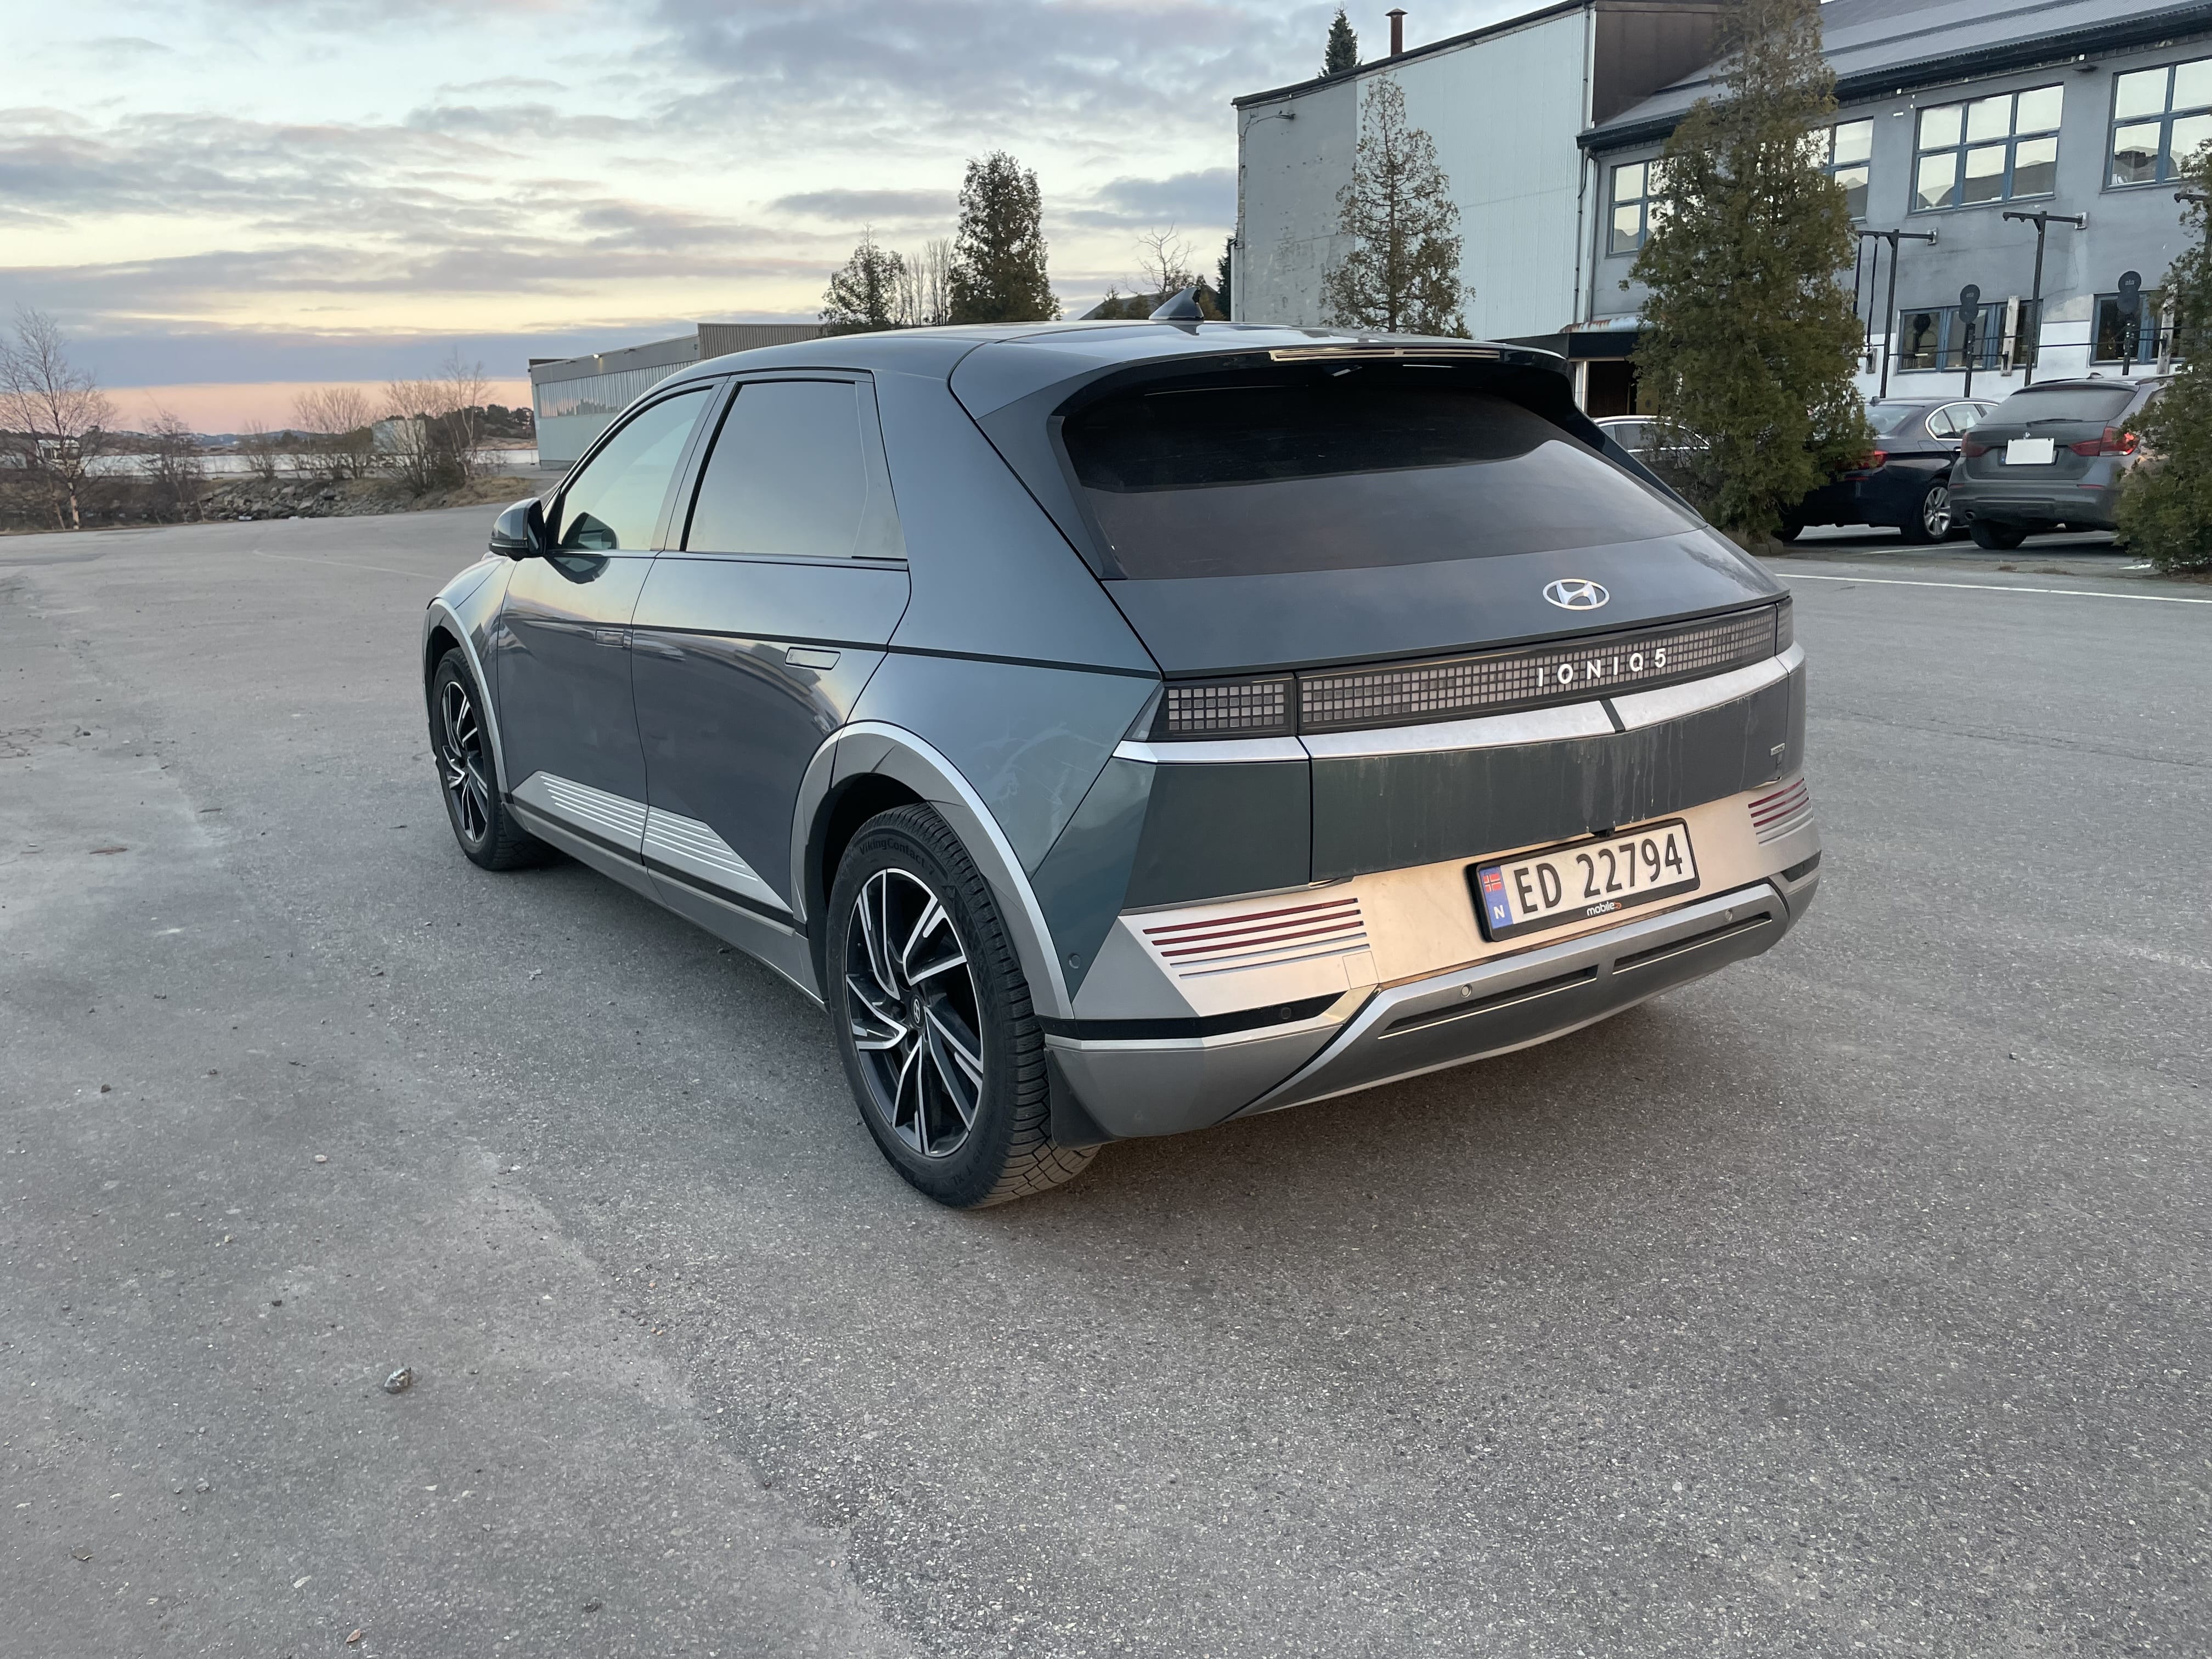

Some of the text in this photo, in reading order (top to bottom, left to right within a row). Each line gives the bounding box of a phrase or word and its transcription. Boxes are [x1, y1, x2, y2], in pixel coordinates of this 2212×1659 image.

[1538, 648, 1667, 687] IONIQ 5
[1513, 833, 1683, 915] ED 22794
[1493, 904, 1505, 920] N
[1586, 901, 1616, 917] mobile
